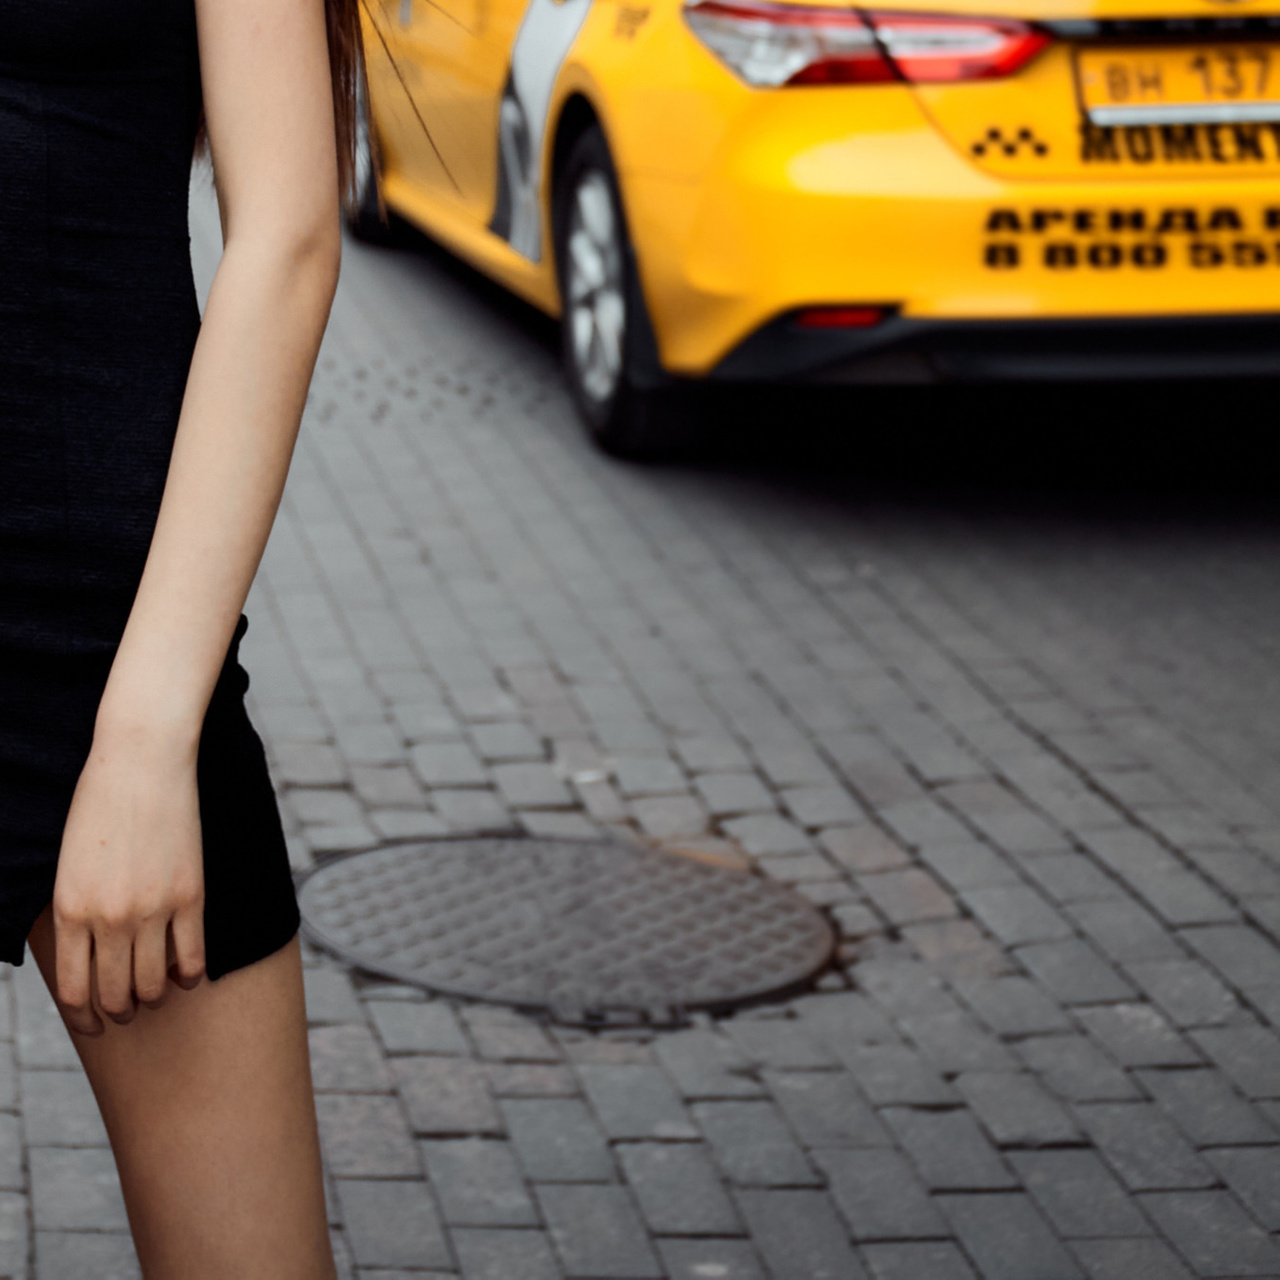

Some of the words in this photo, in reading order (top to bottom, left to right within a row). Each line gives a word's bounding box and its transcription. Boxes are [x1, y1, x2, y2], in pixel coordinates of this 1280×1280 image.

[986, 208, 1242, 235] АРЕНДА
[985, 243, 1020, 268] 8
[1045, 243, 1167, 268] 800
[1189, 242, 1280, 268] 55
